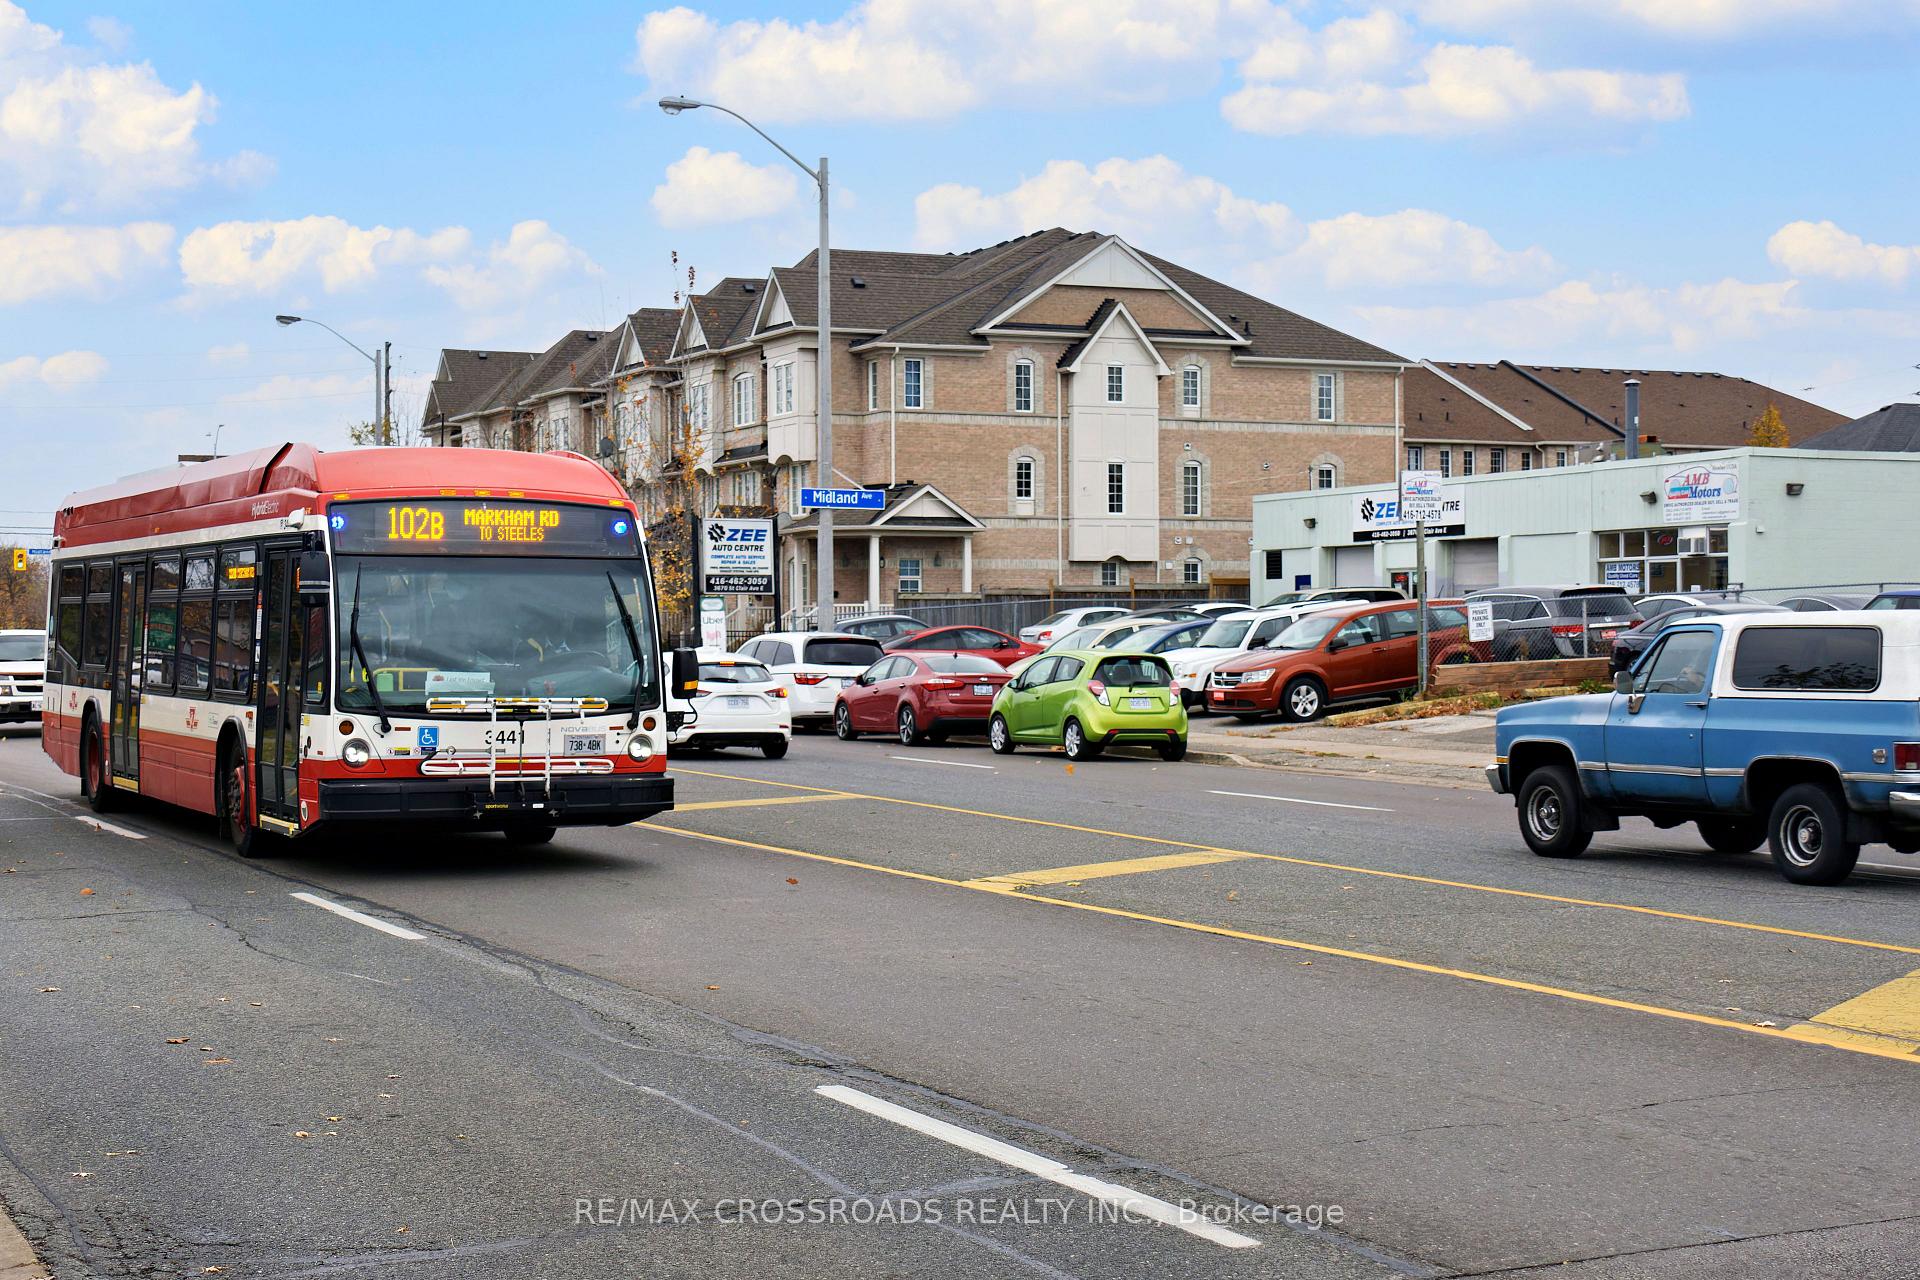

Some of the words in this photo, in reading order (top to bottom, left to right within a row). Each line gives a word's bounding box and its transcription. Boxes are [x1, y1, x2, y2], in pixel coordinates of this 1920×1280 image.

[1682, 472, 1710, 486] AMB
[813, 490, 859, 504] Midland
[861, 492, 873, 500] Ave
[1416, 487, 1433, 495] Motors
[1688, 486, 1722, 498] Motors
[464, 508, 535, 526] MARKHAM
[539, 510, 560, 527] RD
[1403, 509, 1441, 520] 416-712-4578
[388, 507, 445, 540] 102B
[479, 526, 493, 541] TO
[497, 526, 545, 541] STEELES
[726, 528, 768, 542] ZEE
[712, 544, 733, 552] AUTO
[734, 544, 764, 552] CENTRE
[1618, 562, 1639, 571] MOTORS
[709, 577, 768, 585] 416-462-3050
[702, 616, 723, 625] Uber
[1472, 614, 1489, 622] PARKING
[485, 730, 525, 744] 3441
